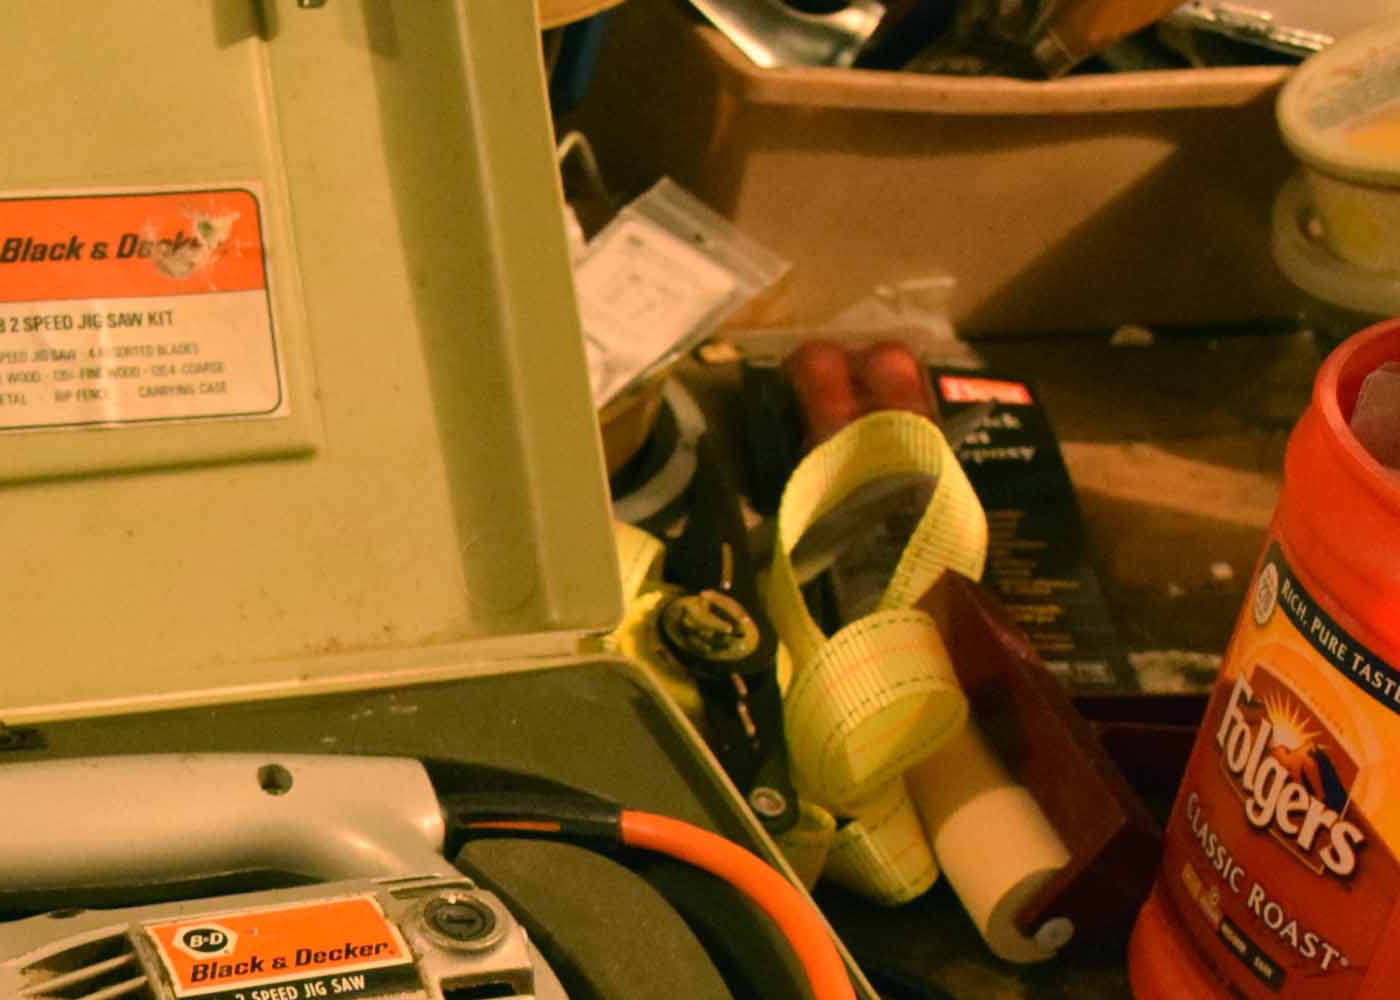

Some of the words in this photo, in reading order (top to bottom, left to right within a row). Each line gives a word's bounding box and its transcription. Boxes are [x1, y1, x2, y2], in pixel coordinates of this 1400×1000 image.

[0, 233, 82, 263] Black
[89, 241, 108, 260] &
[9, 316, 20, 333] 2
[23, 314, 73, 332] SPEED
[106, 311, 143, 329] SAW
[148, 310, 174, 326] KIT
[1310, 616, 1348, 661] PURE
[1216, 672, 1364, 875] Folgers
[1187, 793, 1245, 893] CLASSIC
[191, 955, 264, 983] Black
[271, 956, 288, 969] &
[295, 942, 389, 966] Decker
[304, 982, 327, 998] JIG
[333, 975, 365, 993] SAW
